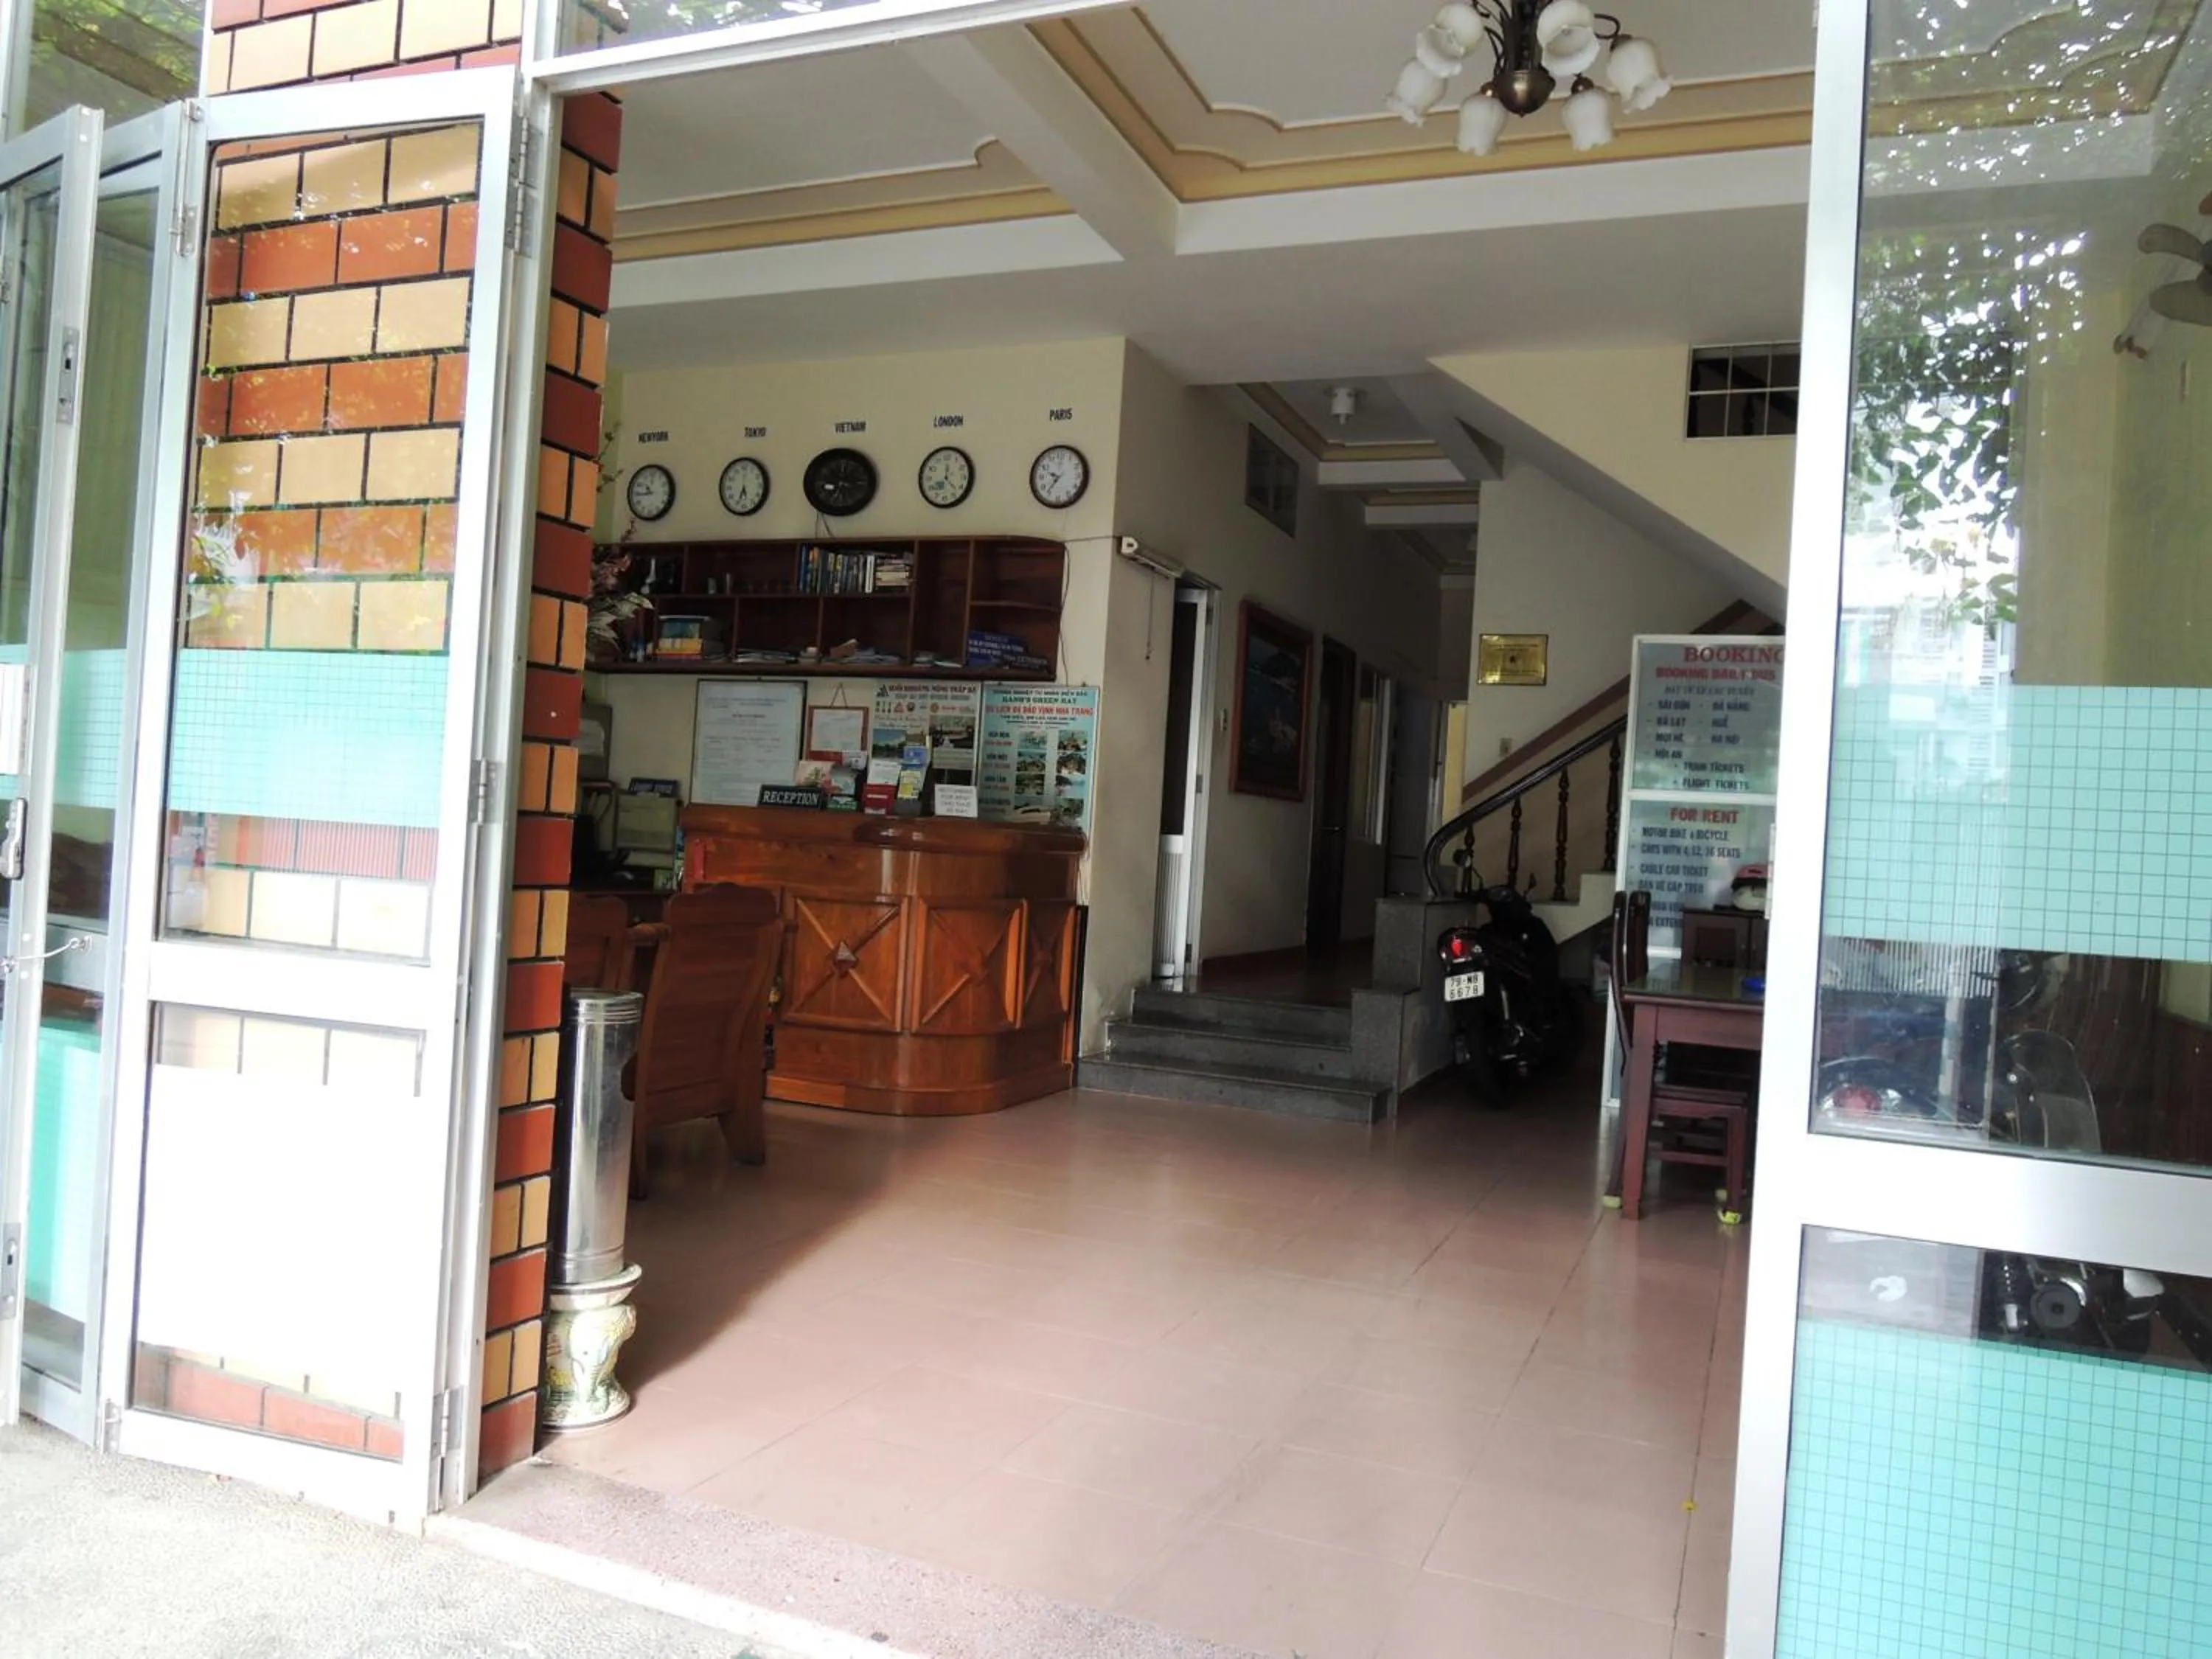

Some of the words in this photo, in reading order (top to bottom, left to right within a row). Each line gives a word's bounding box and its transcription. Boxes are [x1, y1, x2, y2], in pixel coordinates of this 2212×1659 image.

[933, 414, 964, 428] LONDON
[1049, 408, 1074, 422] PARIS
[743, 426, 768, 438] TOKYO
[834, 421, 866, 434] VIETNAM
[1683, 778, 1711, 789] FLIGHT
[762, 790, 819, 806] RECEPTION
[1671, 807, 1698, 822] FOR
[1703, 809, 1739, 824] RENT
[1641, 827, 1667, 838] MOTOR
[1696, 830, 1730, 841] BICYCLE
[1717, 847, 1742, 859] SEATS
